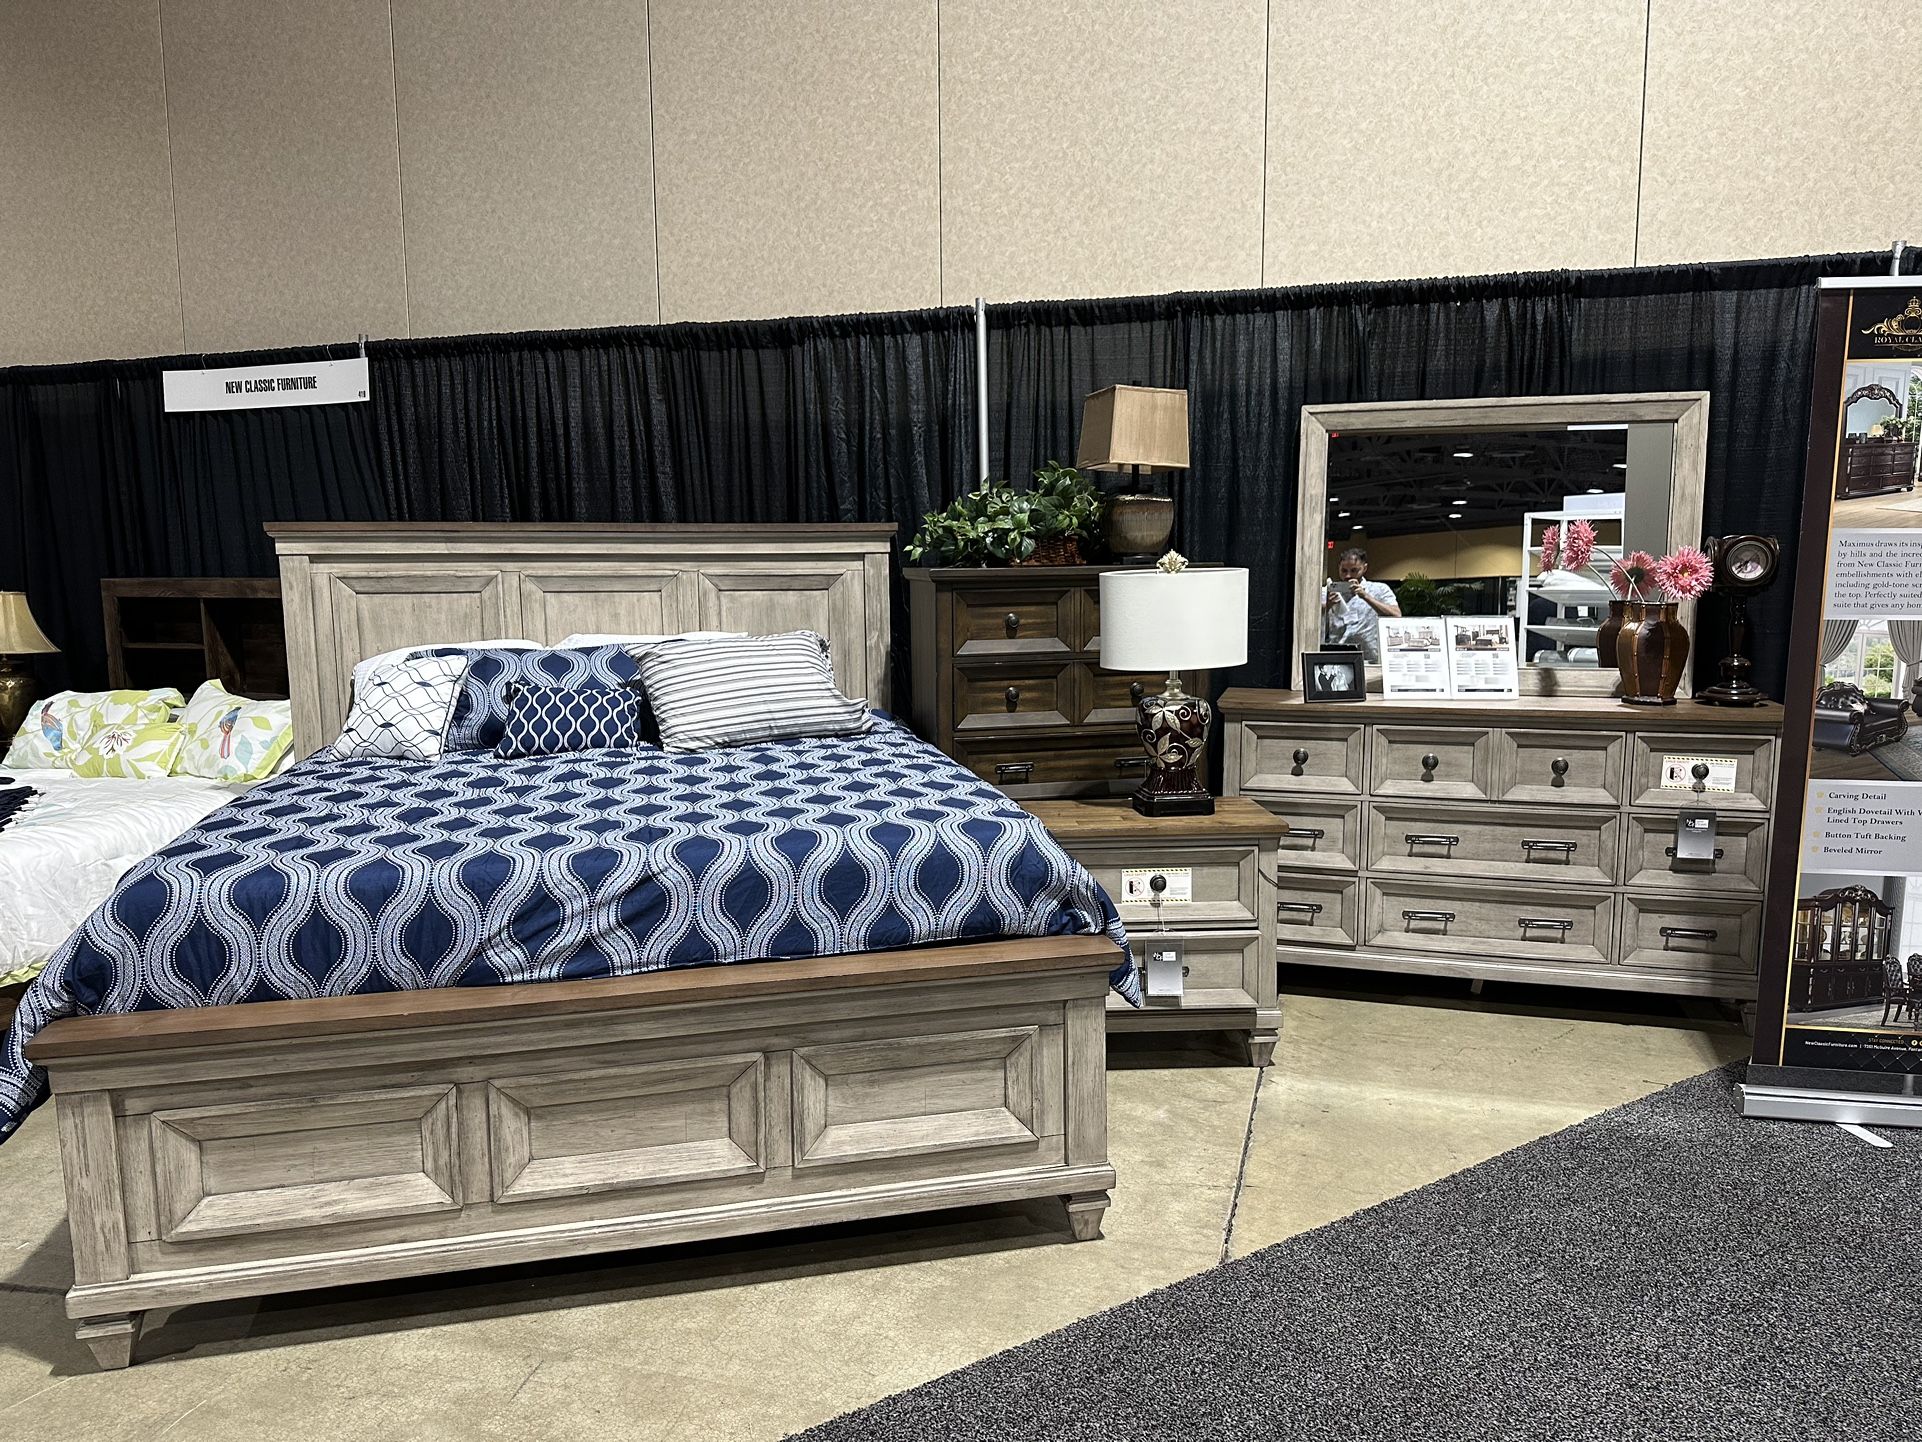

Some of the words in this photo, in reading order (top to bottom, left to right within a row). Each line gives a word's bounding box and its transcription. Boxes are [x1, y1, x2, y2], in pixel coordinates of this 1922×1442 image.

[225, 380, 242, 394] NEW
[244, 378, 276, 394] CLASSIC
[277, 376, 318, 392] FURNITURE
[1838, 551, 1847, 559] by
[1835, 581, 1870, 589] including
[1872, 581, 1909, 590] gold-tone
[1848, 592, 1862, 600] top.
[1865, 591, 1897, 600] Perfectly
[1829, 792, 1859, 801] Carving
[1827, 807, 1856, 815] English
[1851, 818, 1867, 826] Top
[1874, 833, 1906, 842] Backing
